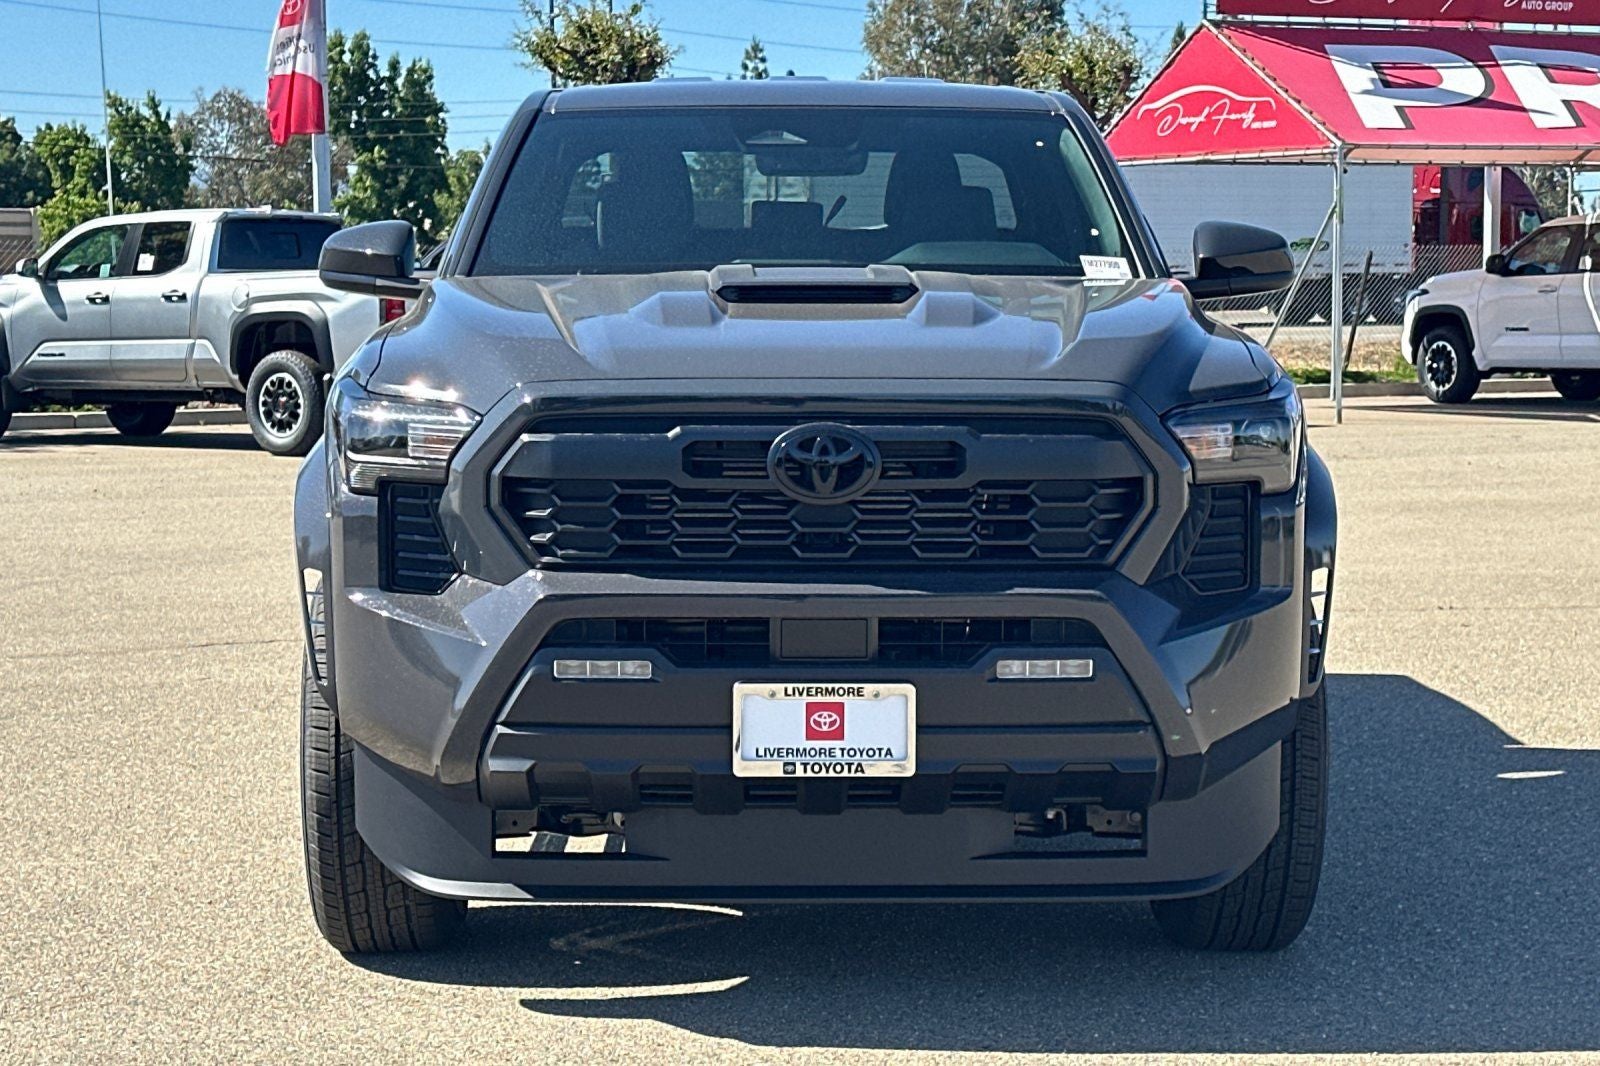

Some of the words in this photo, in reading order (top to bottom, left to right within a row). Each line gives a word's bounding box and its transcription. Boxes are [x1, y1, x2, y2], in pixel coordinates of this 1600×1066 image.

[1521, 0, 1543, 11] AUTO
[1545, 1, 1574, 12] GROUP
[784, 686, 865, 698] LIVERMORE
[755, 747, 836, 758] LIVERMORE
[839, 747, 894, 758] TOYOTA
[801, 762, 866, 775] TOYOTA
